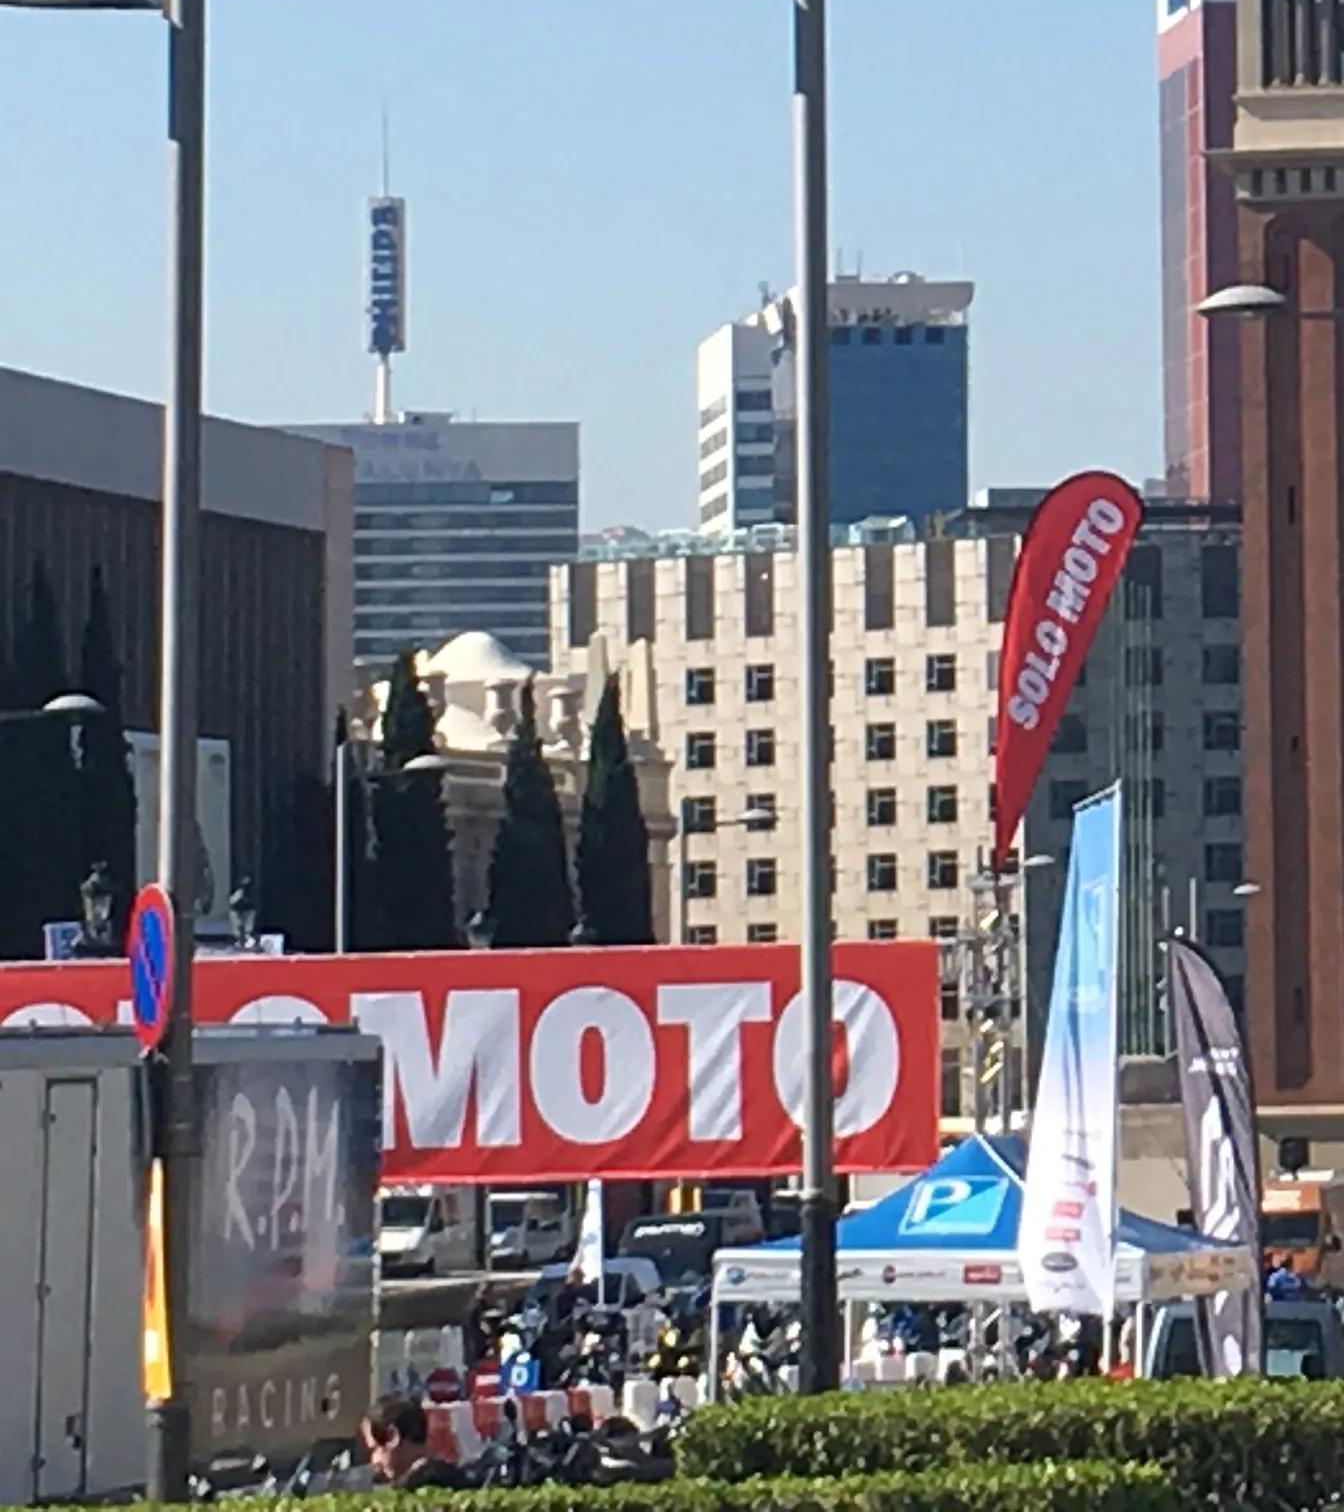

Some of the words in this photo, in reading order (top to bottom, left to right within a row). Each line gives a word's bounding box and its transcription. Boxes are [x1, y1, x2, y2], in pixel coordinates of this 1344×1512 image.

[1007, 619, 1068, 730] SOLO
[1046, 498, 1125, 624] MOTO
[350, 978, 899, 1149] MOTO
[211, 1373, 342, 1436] RACING
